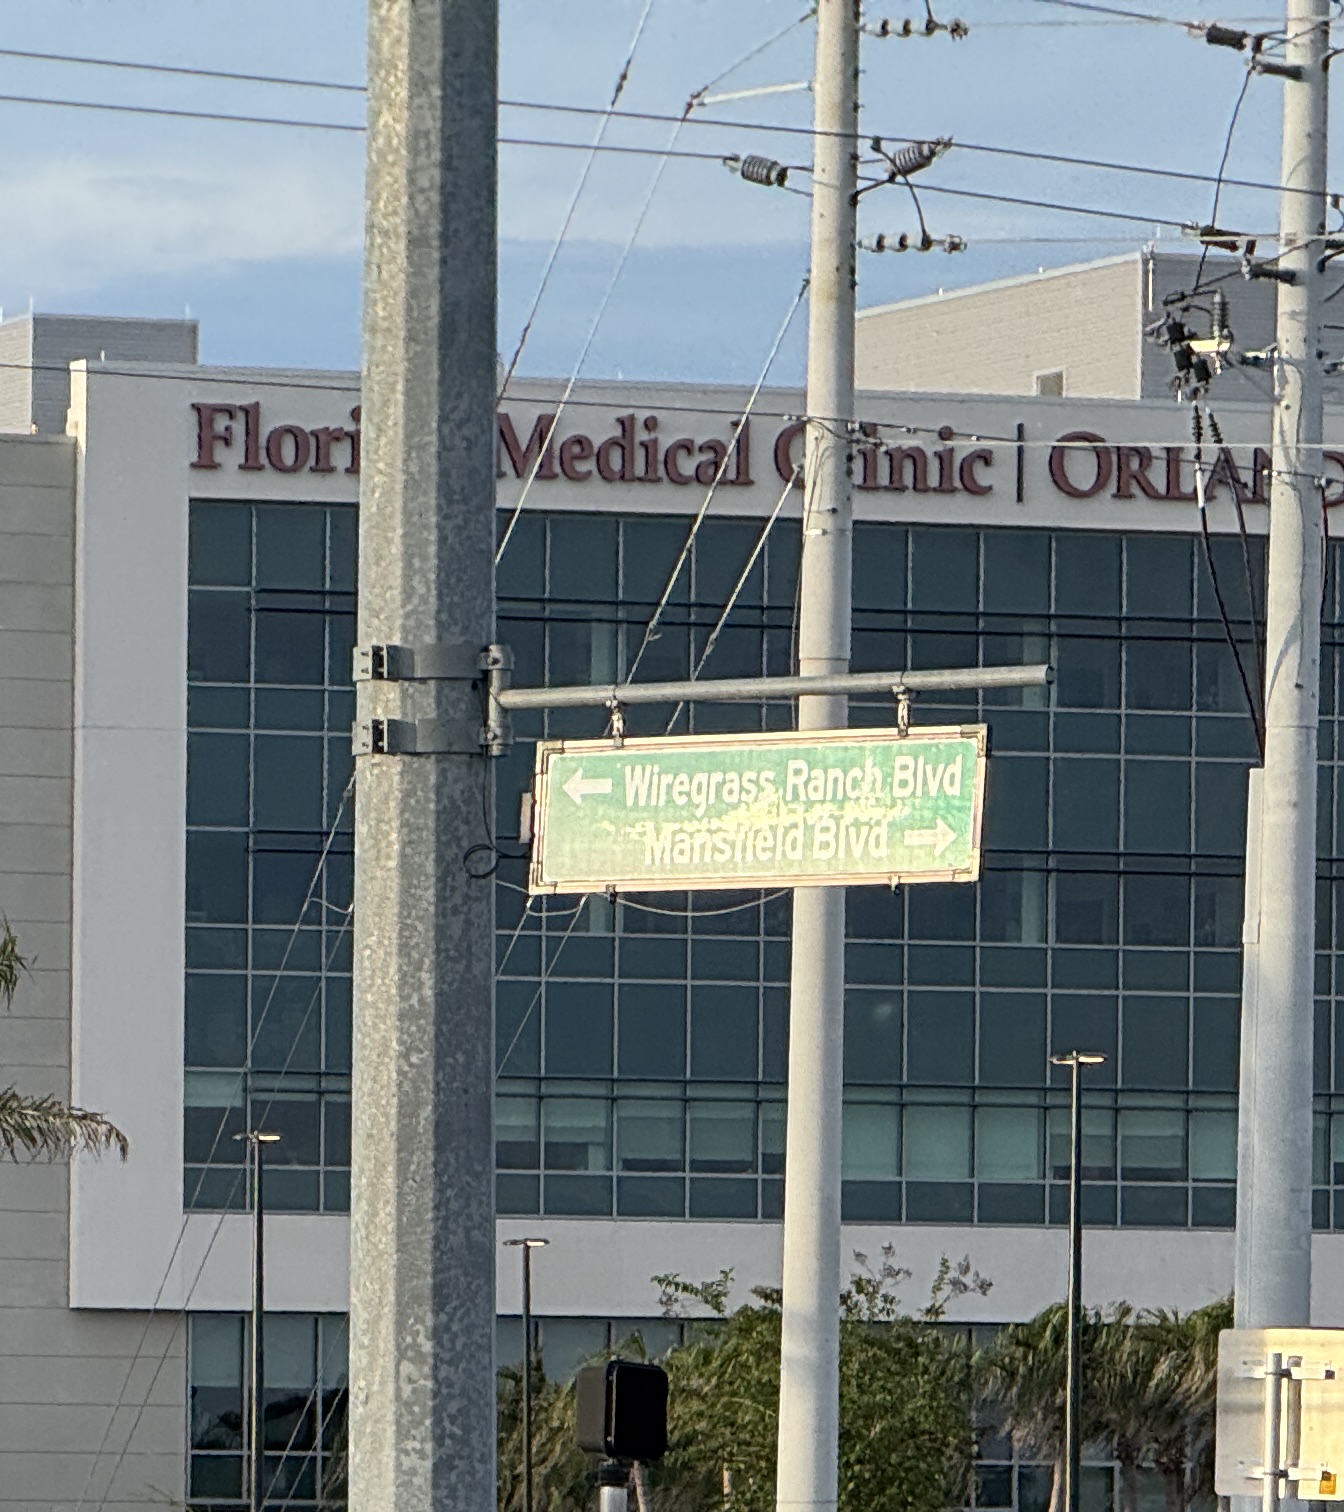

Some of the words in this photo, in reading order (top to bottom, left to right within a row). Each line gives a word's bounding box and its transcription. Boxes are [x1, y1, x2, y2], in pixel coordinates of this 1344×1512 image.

[189, 402, 361, 474] Flori
[495, 411, 755, 487] Medical
[774, 418, 994, 496] Cinic
[624, 763, 776, 818] Wiregrass
[786, 756, 883, 801] Ranch
[892, 754, 963, 798] Blvd
[643, 810, 805, 867] Mansfield
[811, 813, 889, 861] Blvd
